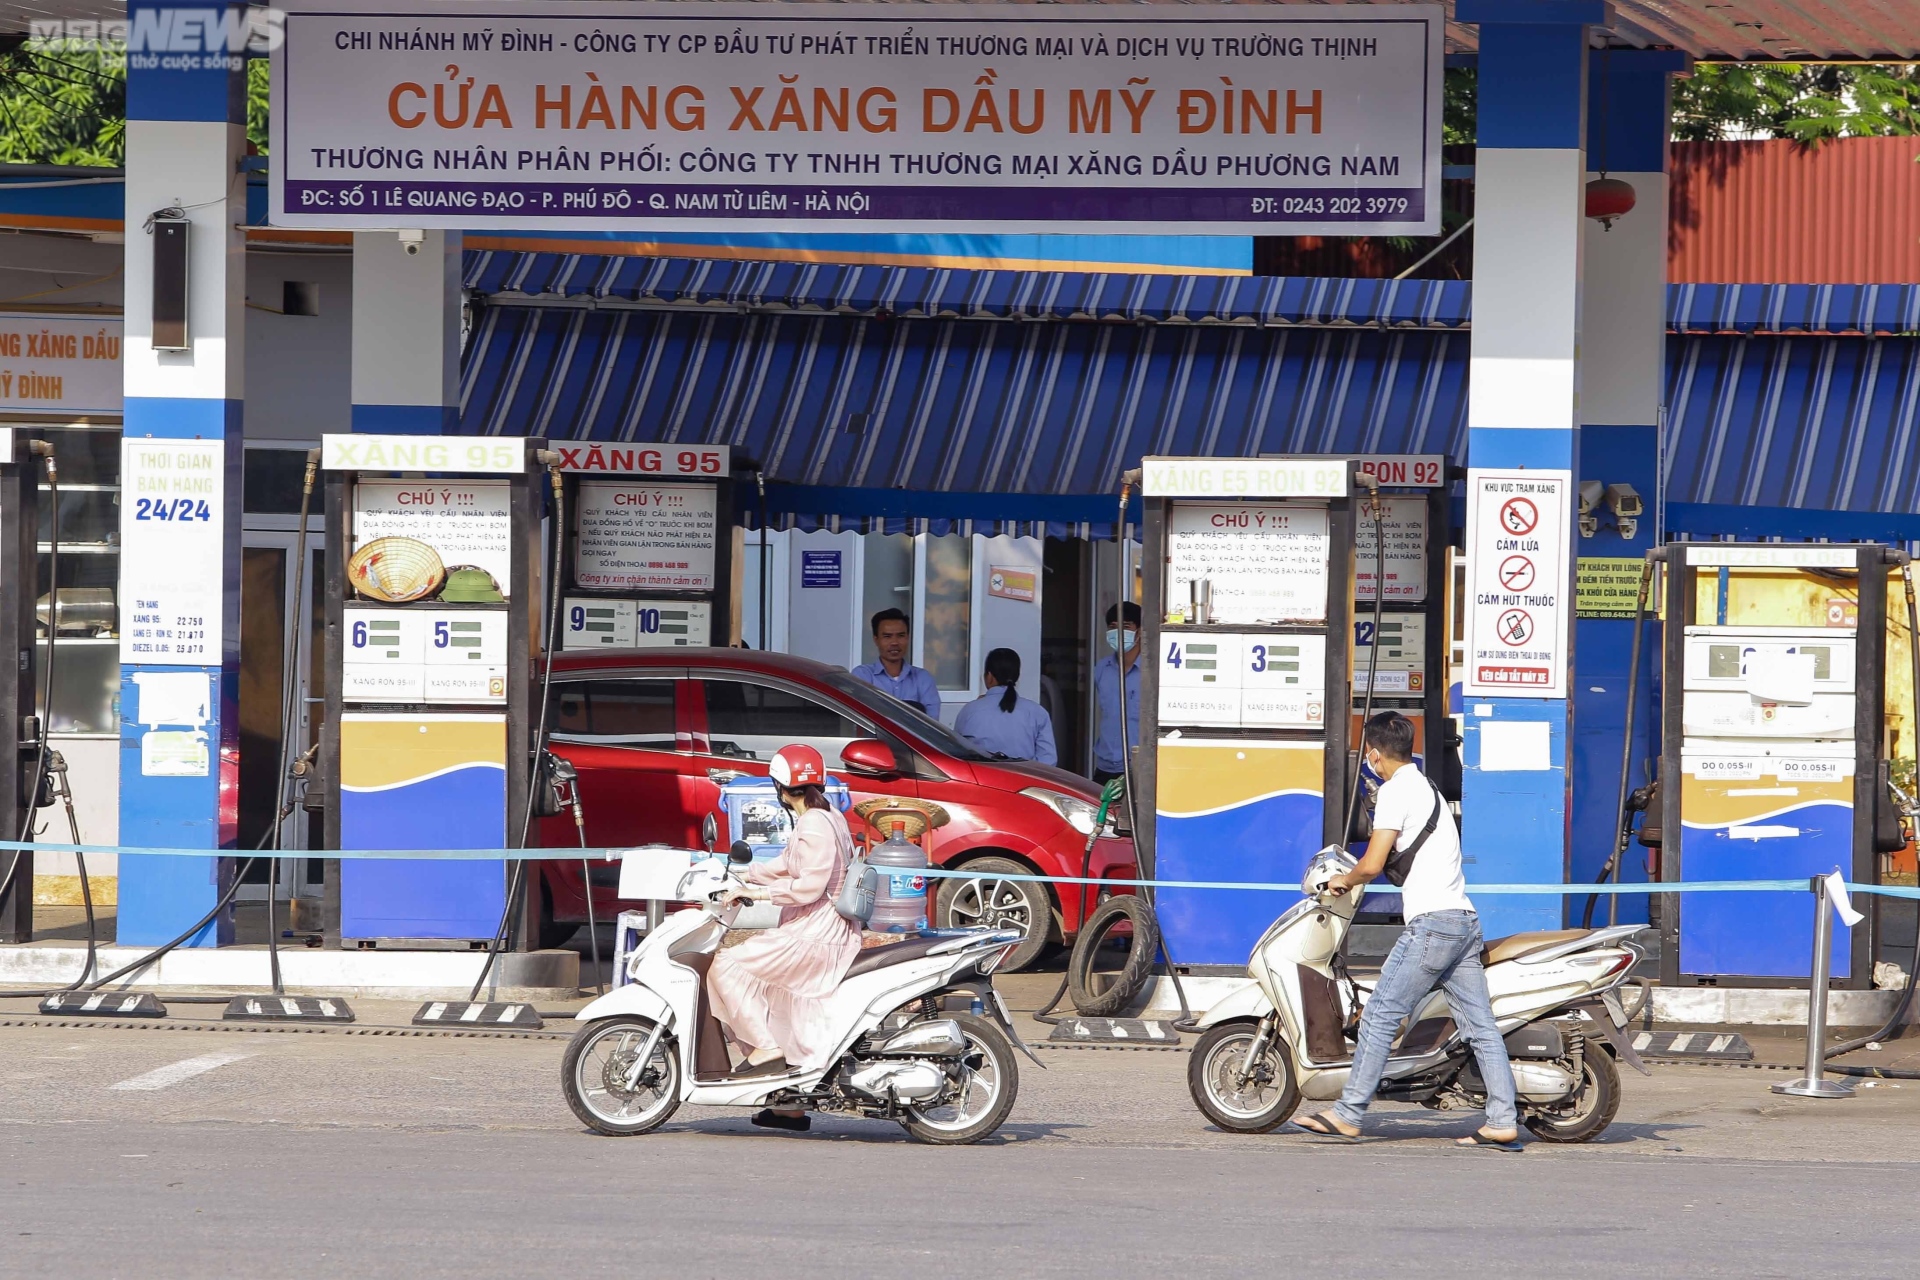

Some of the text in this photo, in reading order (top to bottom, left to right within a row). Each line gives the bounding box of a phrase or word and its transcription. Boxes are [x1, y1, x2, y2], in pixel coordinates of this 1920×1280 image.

[335, 26, 1377, 60] CHI NHÁNH MỸ ĐÌNH CÔNG TY CP ĐẦU TƯ PHÁT TRIỂN THƯƠNG MẠI VÀ DỊCH VỤ TRƯỜNG THỊNH
[388, 63, 1322, 134] CỬA HÀNG XĂNG DẦU MỸ ĐÌNH
[310, 143, 1399, 179] THƯƠNG NHÂN PHÂN PHỐI: CÔNG TY TNHH THƯƠNG MẠI XĂNG DẦU PHƯƠNG NAM
[301, 185, 870, 214] ĐC: SỐ 1 LÊ QUANG ĐẠO P. PHÚ ĐÔ Q. NAM TỪ LIÊM HÀ NỘI
[1251, 198, 1408, 213] ĐT: 0243 202 3979
[26, 329, 77, 359] XĂNG
[83, 328, 119, 360] DẦU
[18, 370, 62, 400] ĐÌNH
[178, 453, 212, 470] GIAN
[335, 439, 514, 469] XĂNG 95
[558, 444, 721, 474] XĂNG 95
[1150, 466, 1341, 493] XĂNG E5 RON 92
[1414, 462, 1439, 484] 92
[397, 489, 435, 505] CHÚ
[440, 489, 452, 505] Ý
[613, 490, 648, 506] CHÚ
[652, 491, 663, 506] Ý
[1485, 483, 1499, 492] KHU
[136, 498, 211, 521] 24/24
[605, 508, 629, 516] KHÁCH
[1211, 511, 1249, 527] CHÚ
[1254, 511, 1267, 527] Ý
[1588, 563, 1610, 571] KHÁCH
[1624, 562, 1642, 572] LÒNG
[1699, 550, 1783, 564] DIEZEL
[1619, 587, 1637, 597] HÀNG
[570, 606, 585, 631] 9
[638, 608, 660, 634] 10
[353, 621, 367, 648] 6
[434, 621, 449, 648] 5
[1354, 621, 1376, 646] 12
[1167, 642, 1182, 669] 4
[1251, 645, 1266, 672] 3
[1702, 762, 1716, 770] DO
[1785, 764, 1799, 772] DO
